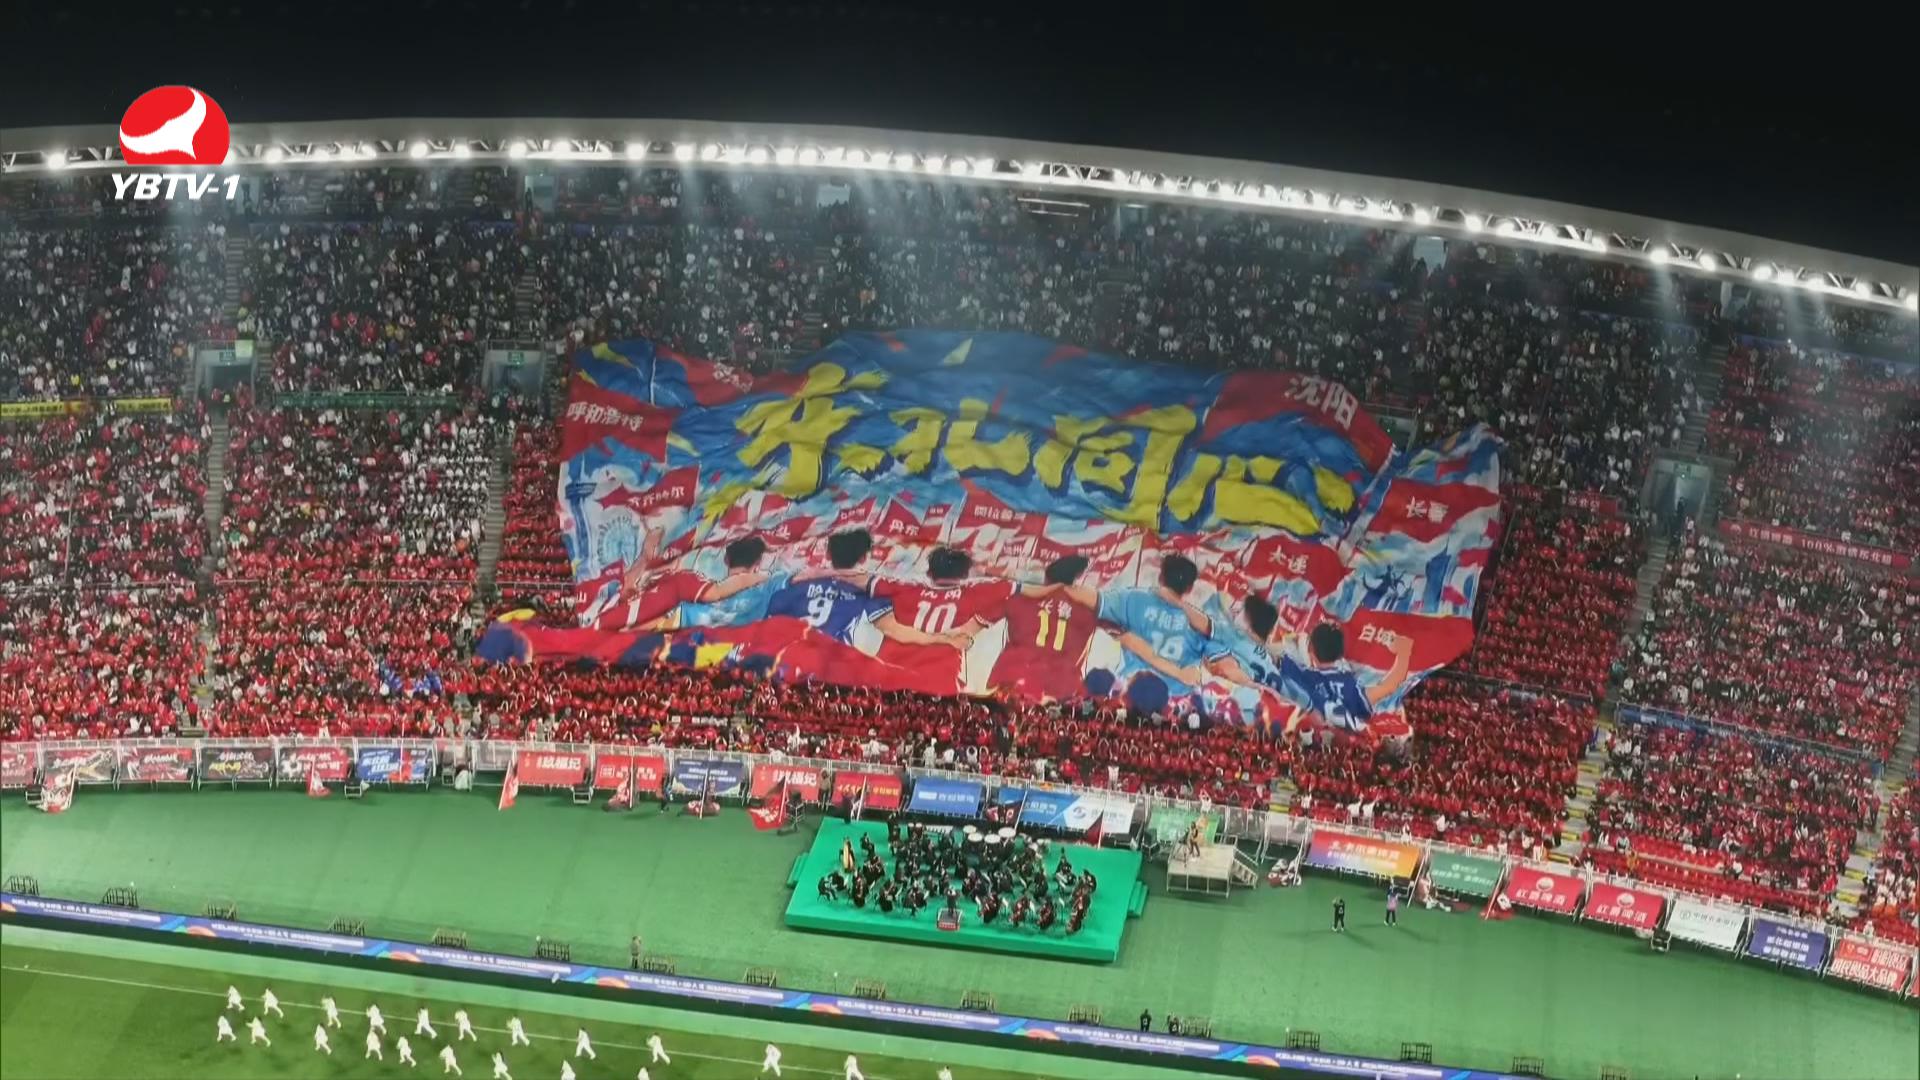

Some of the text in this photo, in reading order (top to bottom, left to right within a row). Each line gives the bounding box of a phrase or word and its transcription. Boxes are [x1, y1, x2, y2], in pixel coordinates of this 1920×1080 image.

[1284, 375, 1358, 430] 沈阳
[888, 518, 919, 536] 丹东
[1267, 544, 1309, 574] 大连
[807, 597, 834, 627] 9
[913, 600, 957, 634] 10
[1035, 609, 1068, 651] 11
[1358, 622, 1396, 647] 白城
